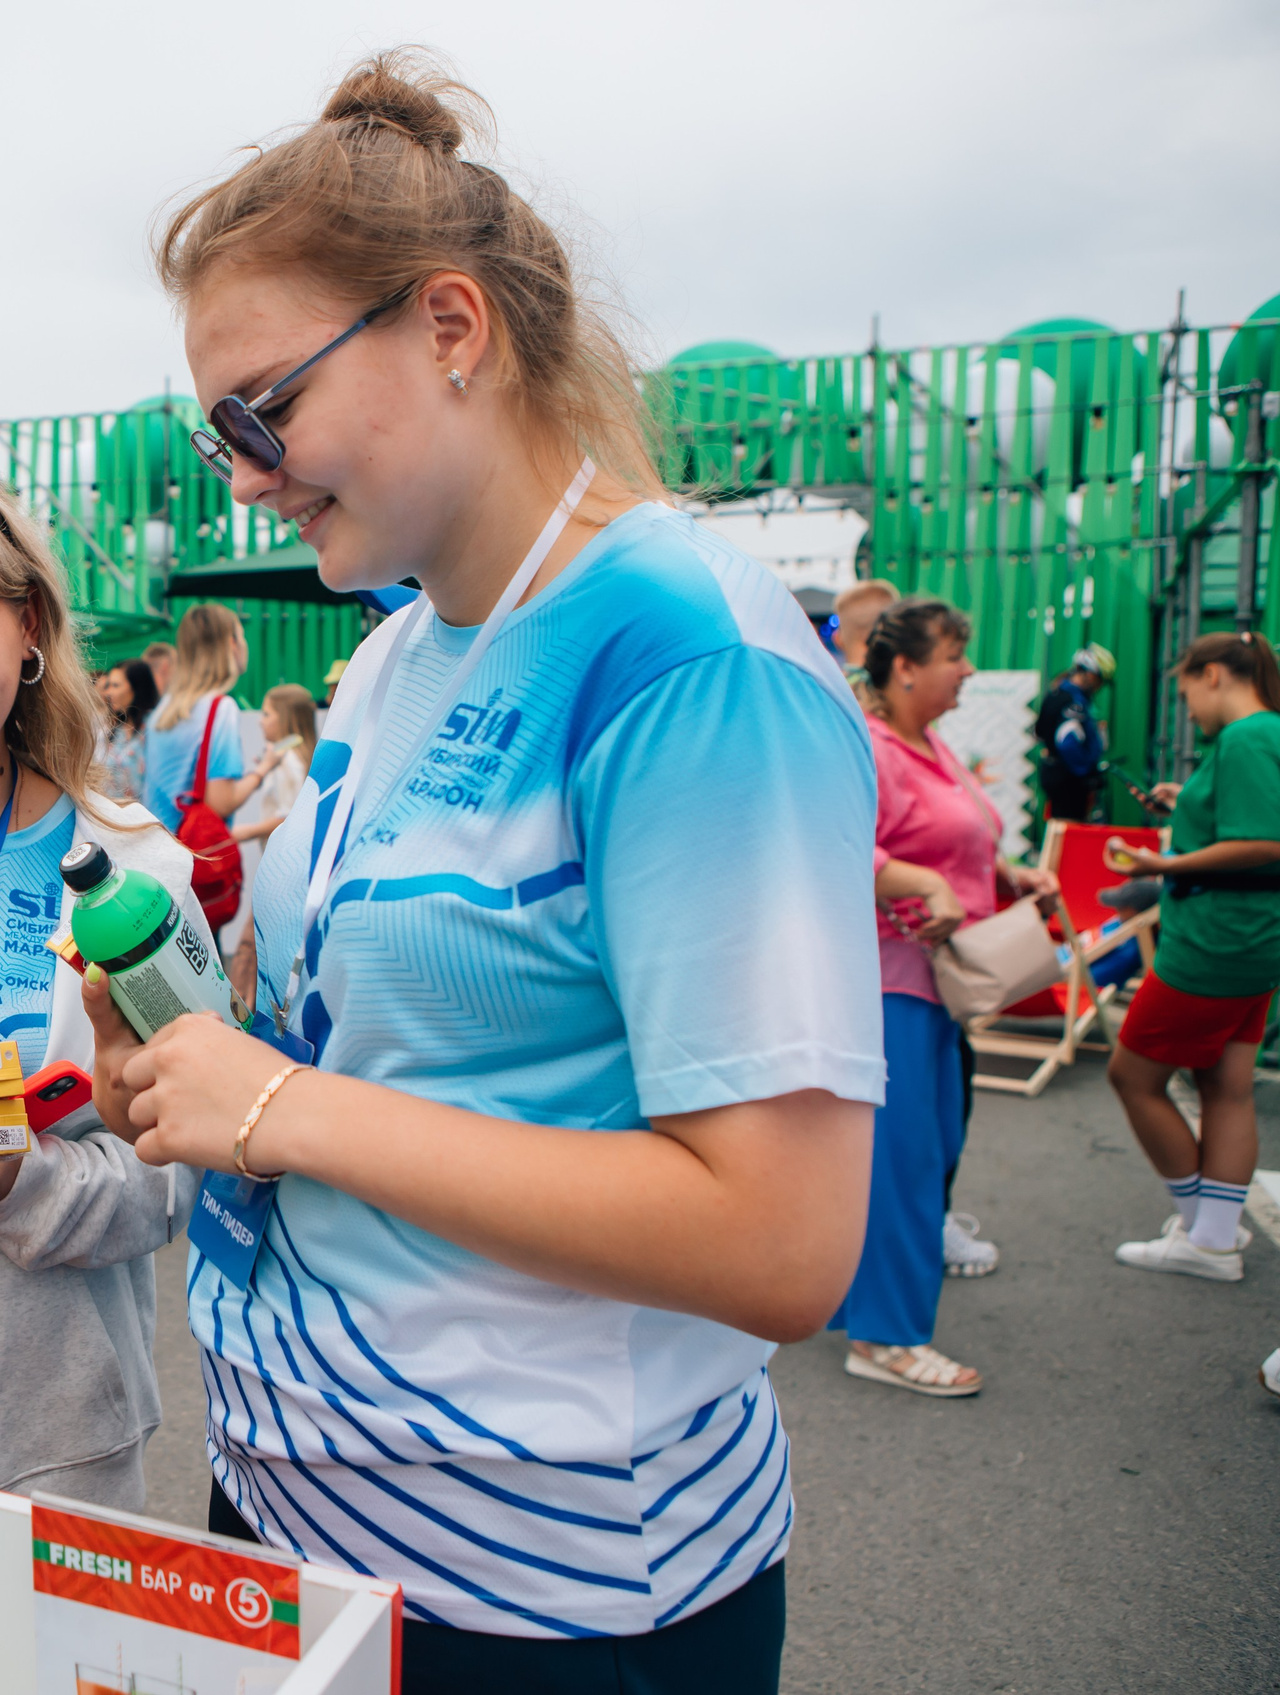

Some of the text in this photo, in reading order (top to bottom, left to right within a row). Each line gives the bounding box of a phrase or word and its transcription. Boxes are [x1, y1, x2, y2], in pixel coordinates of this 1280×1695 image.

[5, 976, 49, 992] ОМСК
[201, 1189, 254, 1248] ТИМ-ЛИДЕР
[49, 1542, 133, 1584] FRESH
[141, 1564, 182, 1595] БАР
